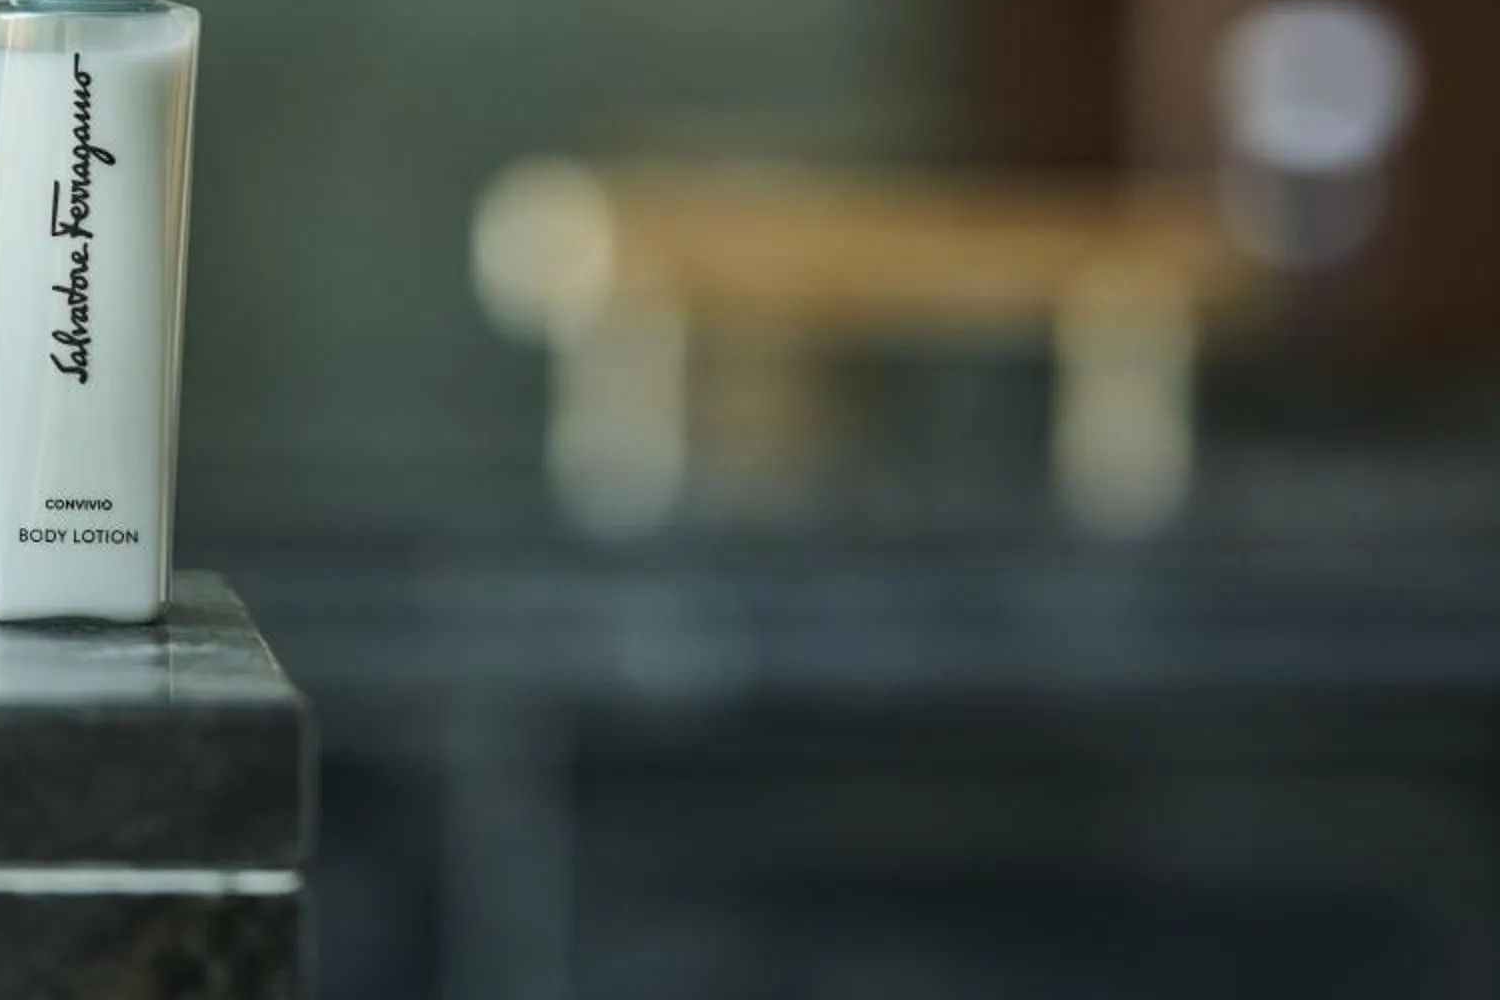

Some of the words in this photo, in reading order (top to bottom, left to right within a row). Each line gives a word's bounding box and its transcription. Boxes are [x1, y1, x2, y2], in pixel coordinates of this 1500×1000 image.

[50, 52, 117, 239] Ferragamo
[49, 242, 90, 384] Salvatore
[19, 528, 68, 544] BODY
[74, 528, 139, 545] LOTION
[44, 498, 113, 512] CONVIVIO
